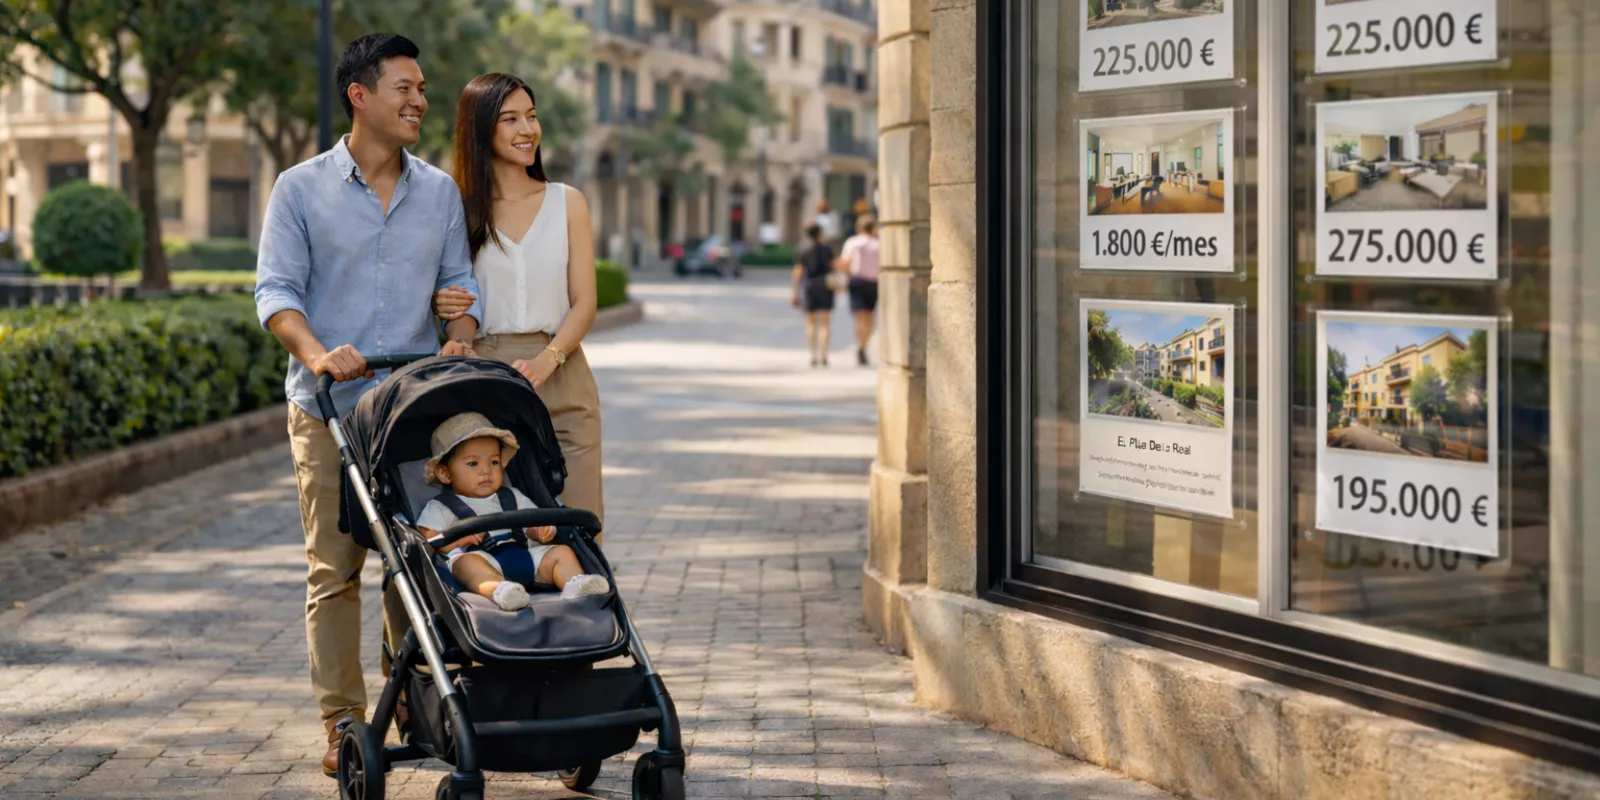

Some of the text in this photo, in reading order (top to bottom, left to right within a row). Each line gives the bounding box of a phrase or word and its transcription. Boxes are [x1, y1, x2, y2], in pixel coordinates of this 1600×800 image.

[1326, 11, 1483, 58] 225.000 €
[1092, 36, 1215, 77] 225.000 €
[1092, 228, 1218, 259] 1.800 €/mes
[1328, 228, 1486, 265] 275.000 €
[1172, 442, 1192, 455] Real
[1333, 474, 1489, 527] 195.000 €
